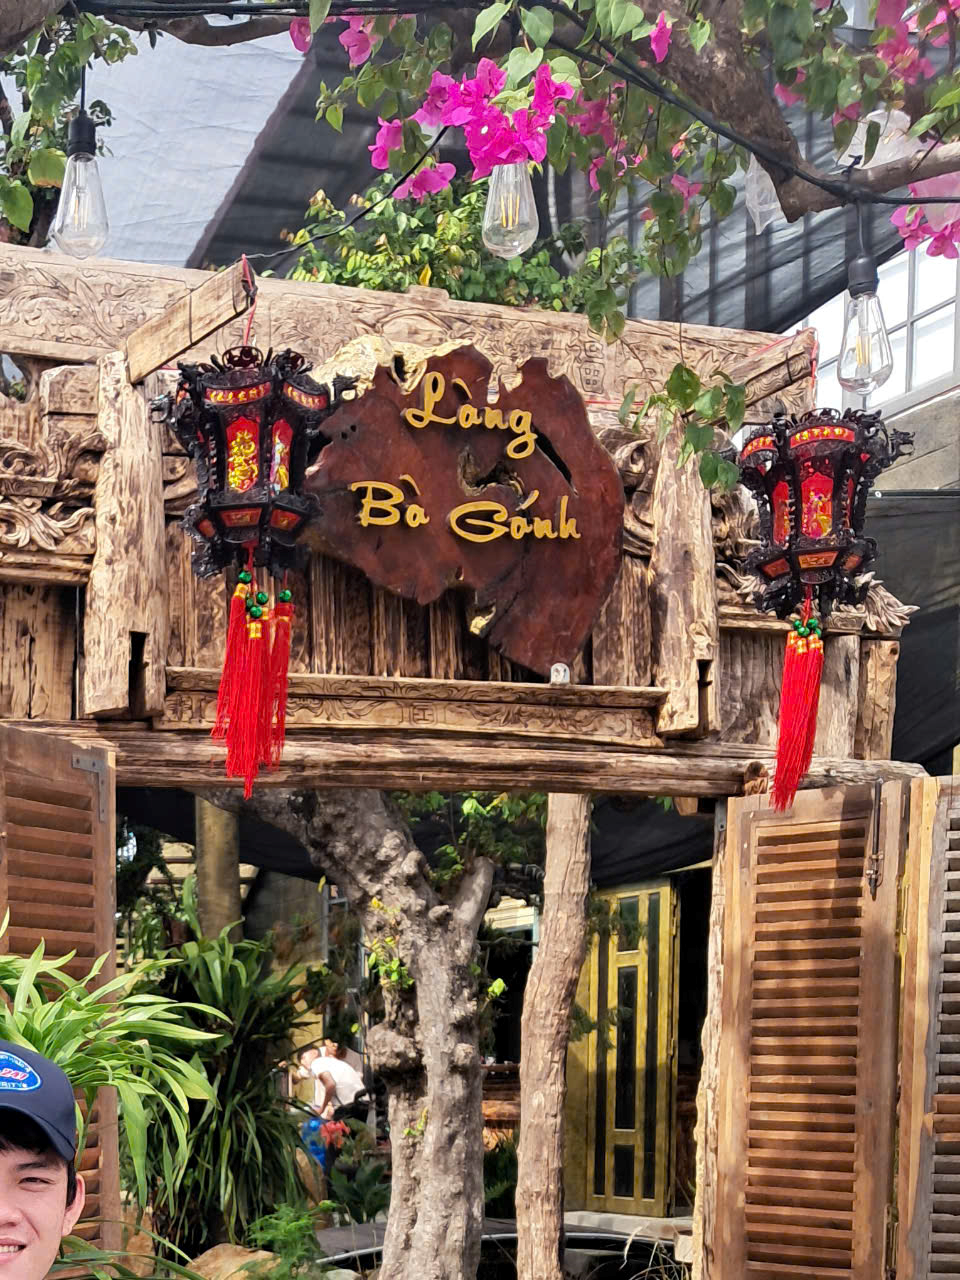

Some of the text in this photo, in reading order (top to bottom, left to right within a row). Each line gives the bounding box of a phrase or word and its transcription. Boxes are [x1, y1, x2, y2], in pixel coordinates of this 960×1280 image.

[402, 371, 538, 459] Làng
[349, 474, 581, 542] Bà Gánh
